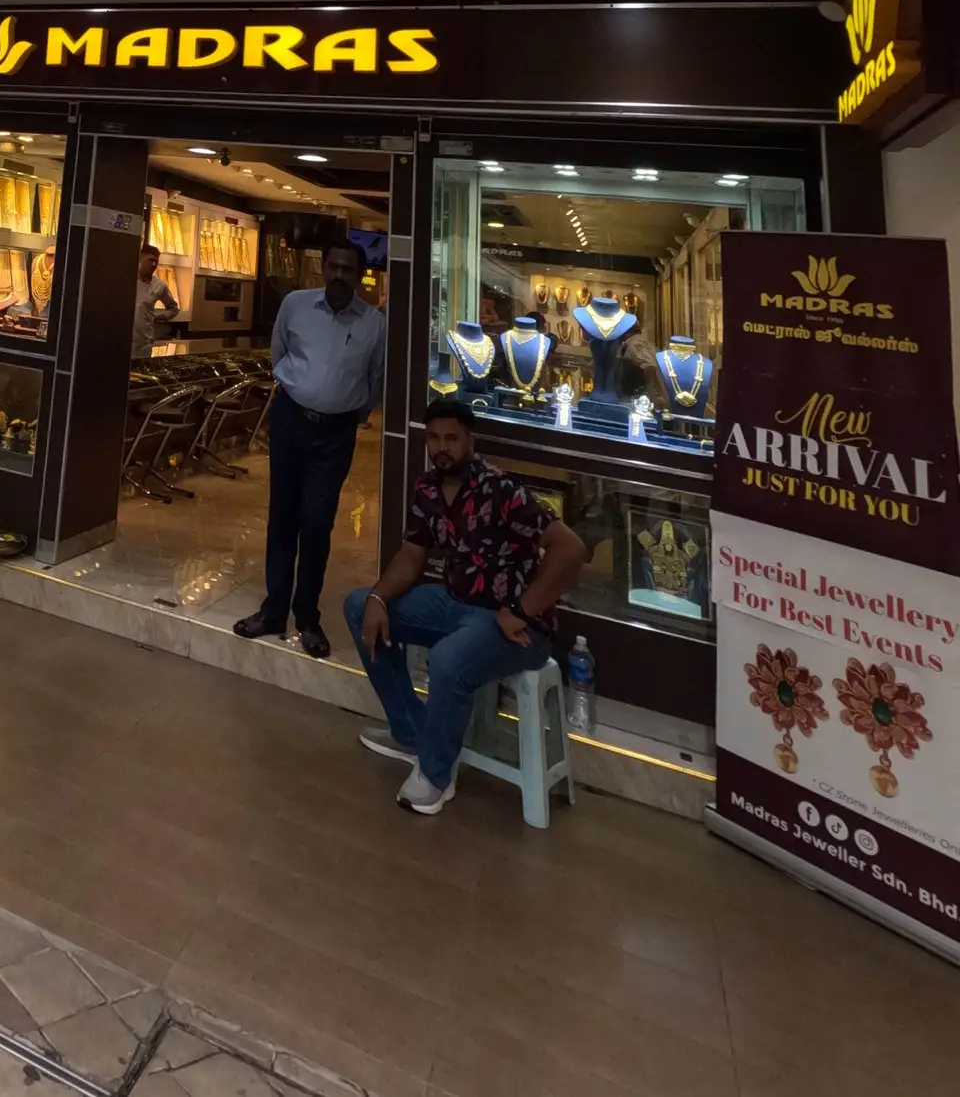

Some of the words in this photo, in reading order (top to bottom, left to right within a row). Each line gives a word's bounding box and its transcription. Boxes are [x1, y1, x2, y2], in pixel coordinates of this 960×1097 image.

[45, 24, 440, 74] MADRAS
[838, 40, 897, 123] MADRAS
[760, 292, 894, 320] MADRAS
[774, 391, 873, 447] New
[722, 422, 947, 503] ARRIVAL
[742, 467, 800, 498] JUST
[804, 480, 857, 511] FOR
[863, 494, 920, 526] YOU
[718, 545, 807, 592] Special
[813, 574, 959, 644] Jewellery
[732, 581, 774, 613] For
[779, 595, 837, 637] Best
[842, 617, 944, 673] Events
[836, 790, 869, 811] Stone
[730, 791, 789, 832] Madras
[793, 824, 866, 874] Jeweller
[871, 864, 913, 897] Sdn.
